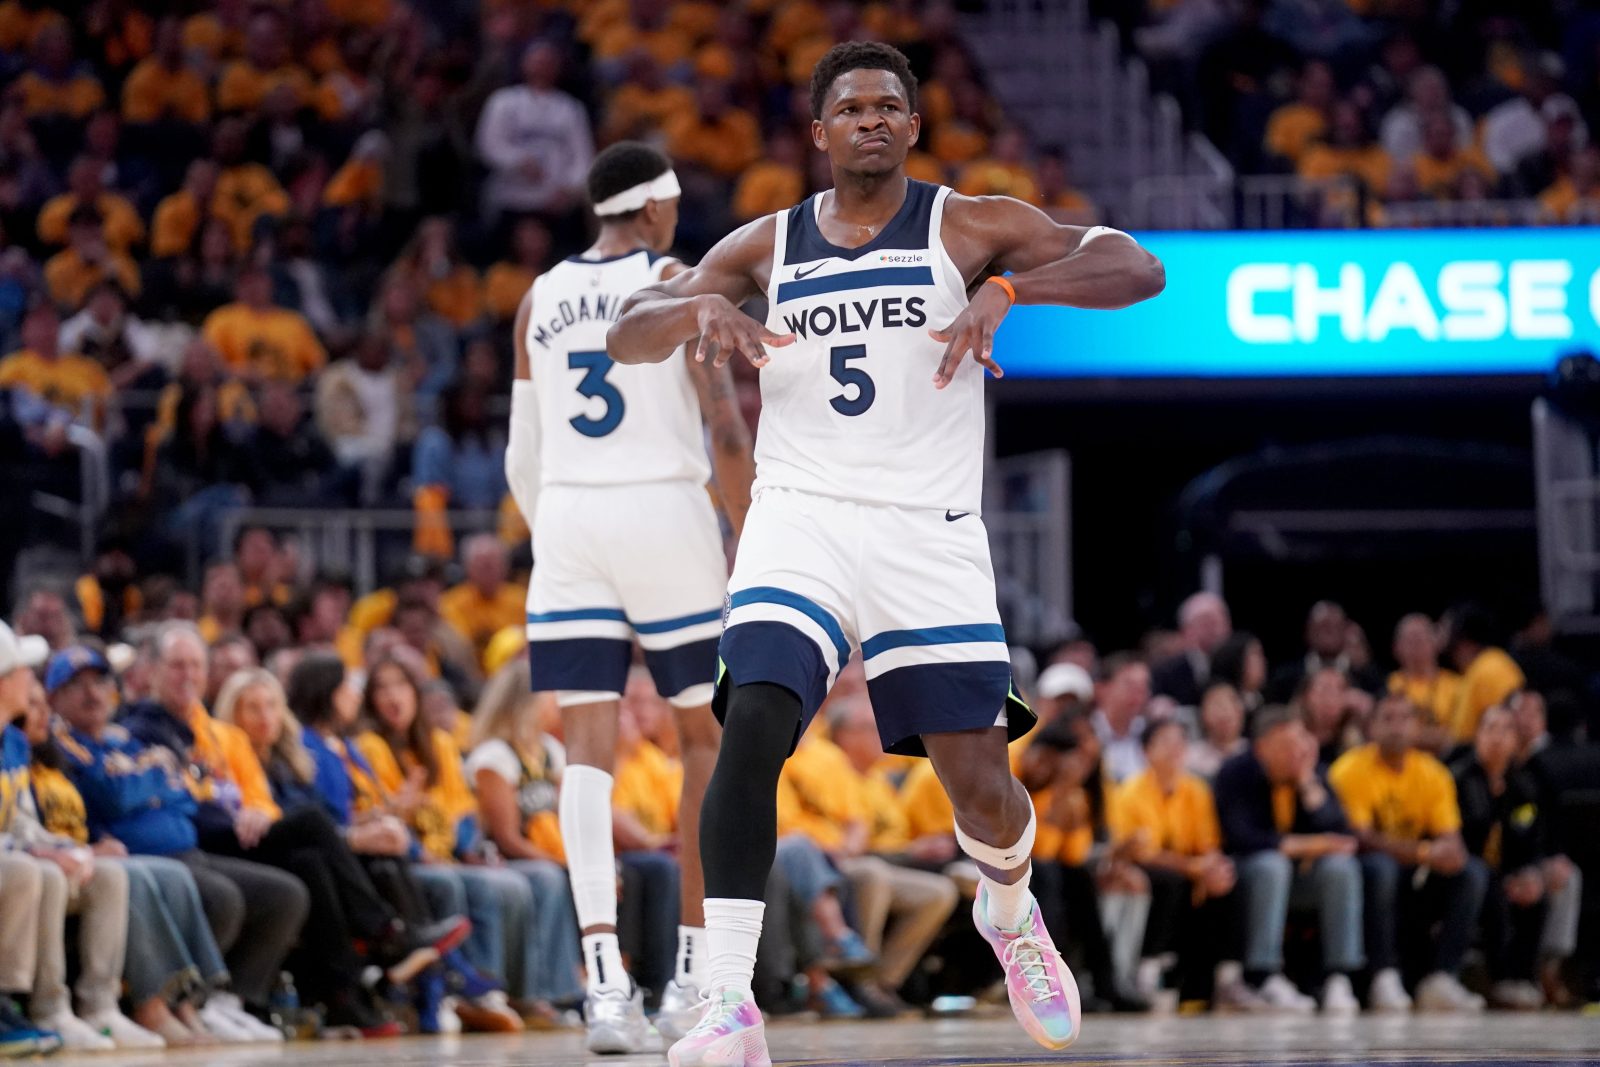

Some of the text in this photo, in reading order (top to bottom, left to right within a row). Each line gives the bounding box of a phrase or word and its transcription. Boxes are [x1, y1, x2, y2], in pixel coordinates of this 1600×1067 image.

[888, 254, 923, 263] sezzle
[783, 296, 927, 343] WOLVES
[1226, 260, 1573, 344] CHASE
[567, 350, 625, 438] 3
[829, 343, 876, 417] 5
